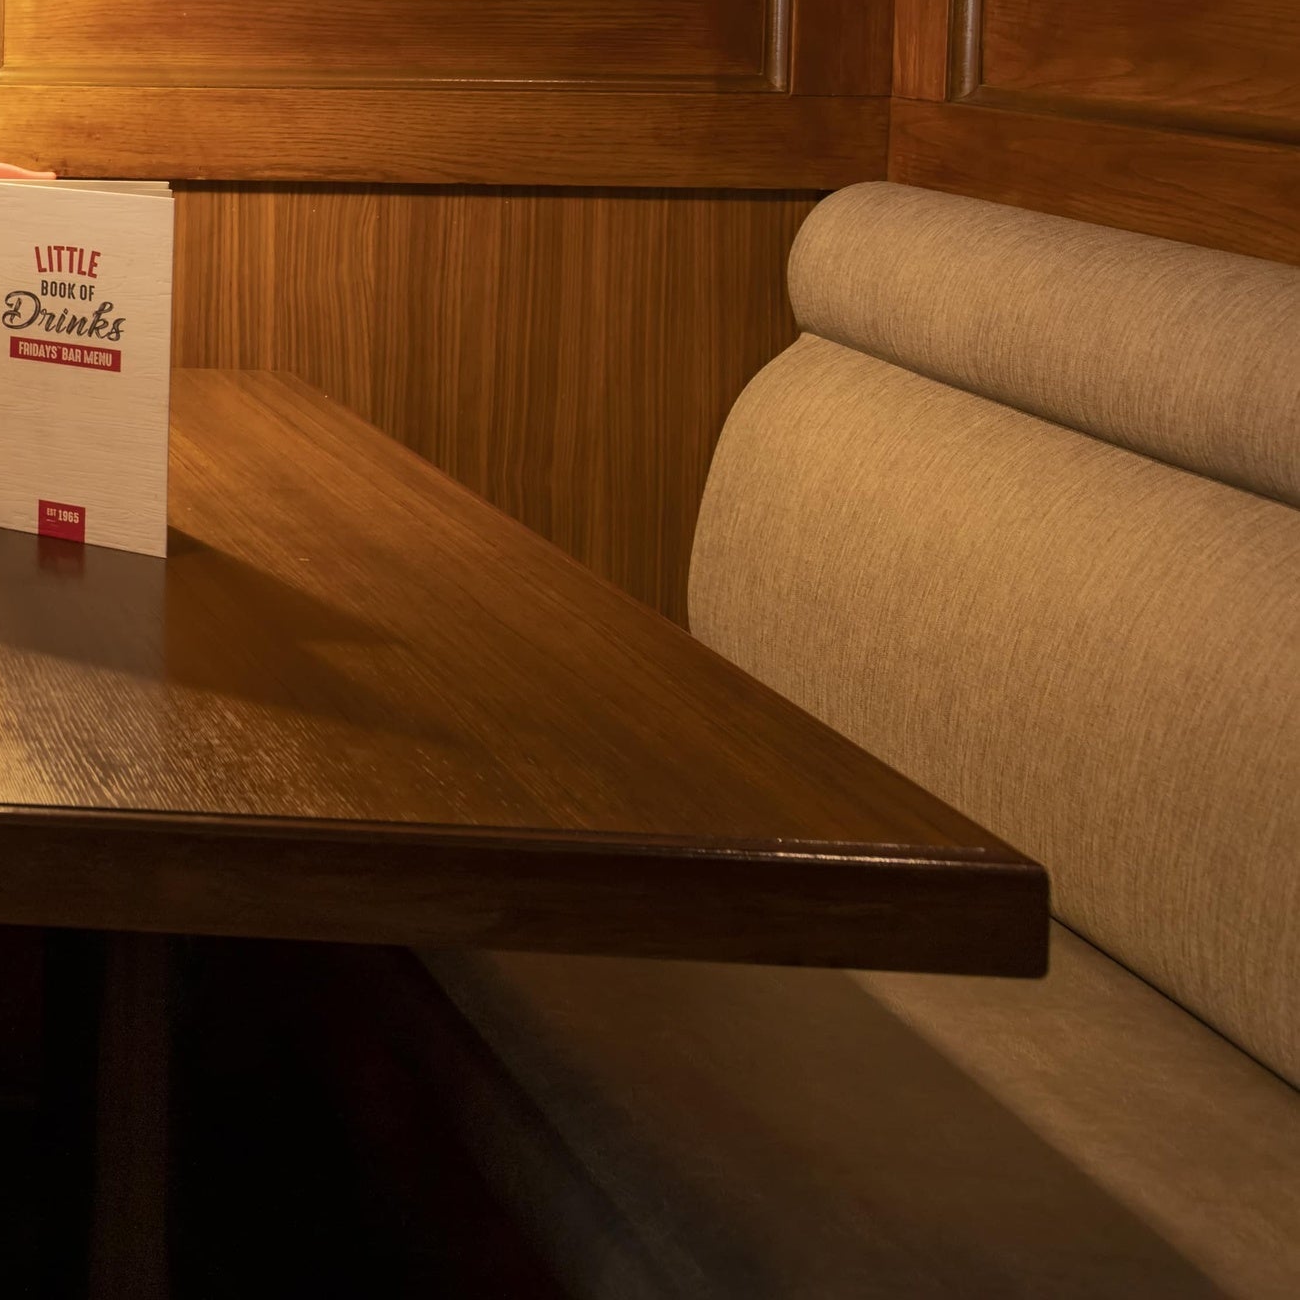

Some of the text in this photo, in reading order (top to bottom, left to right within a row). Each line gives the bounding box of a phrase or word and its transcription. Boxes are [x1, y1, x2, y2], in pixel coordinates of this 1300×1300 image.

[35, 245, 101, 279] LITTLE
[41, 280, 95, 301] BOOK OF
[2, 290, 126, 341] Drinks
[62, 347, 82, 362] BAR
[84, 350, 112, 367] MENU
[58, 509, 80, 524] 1965
